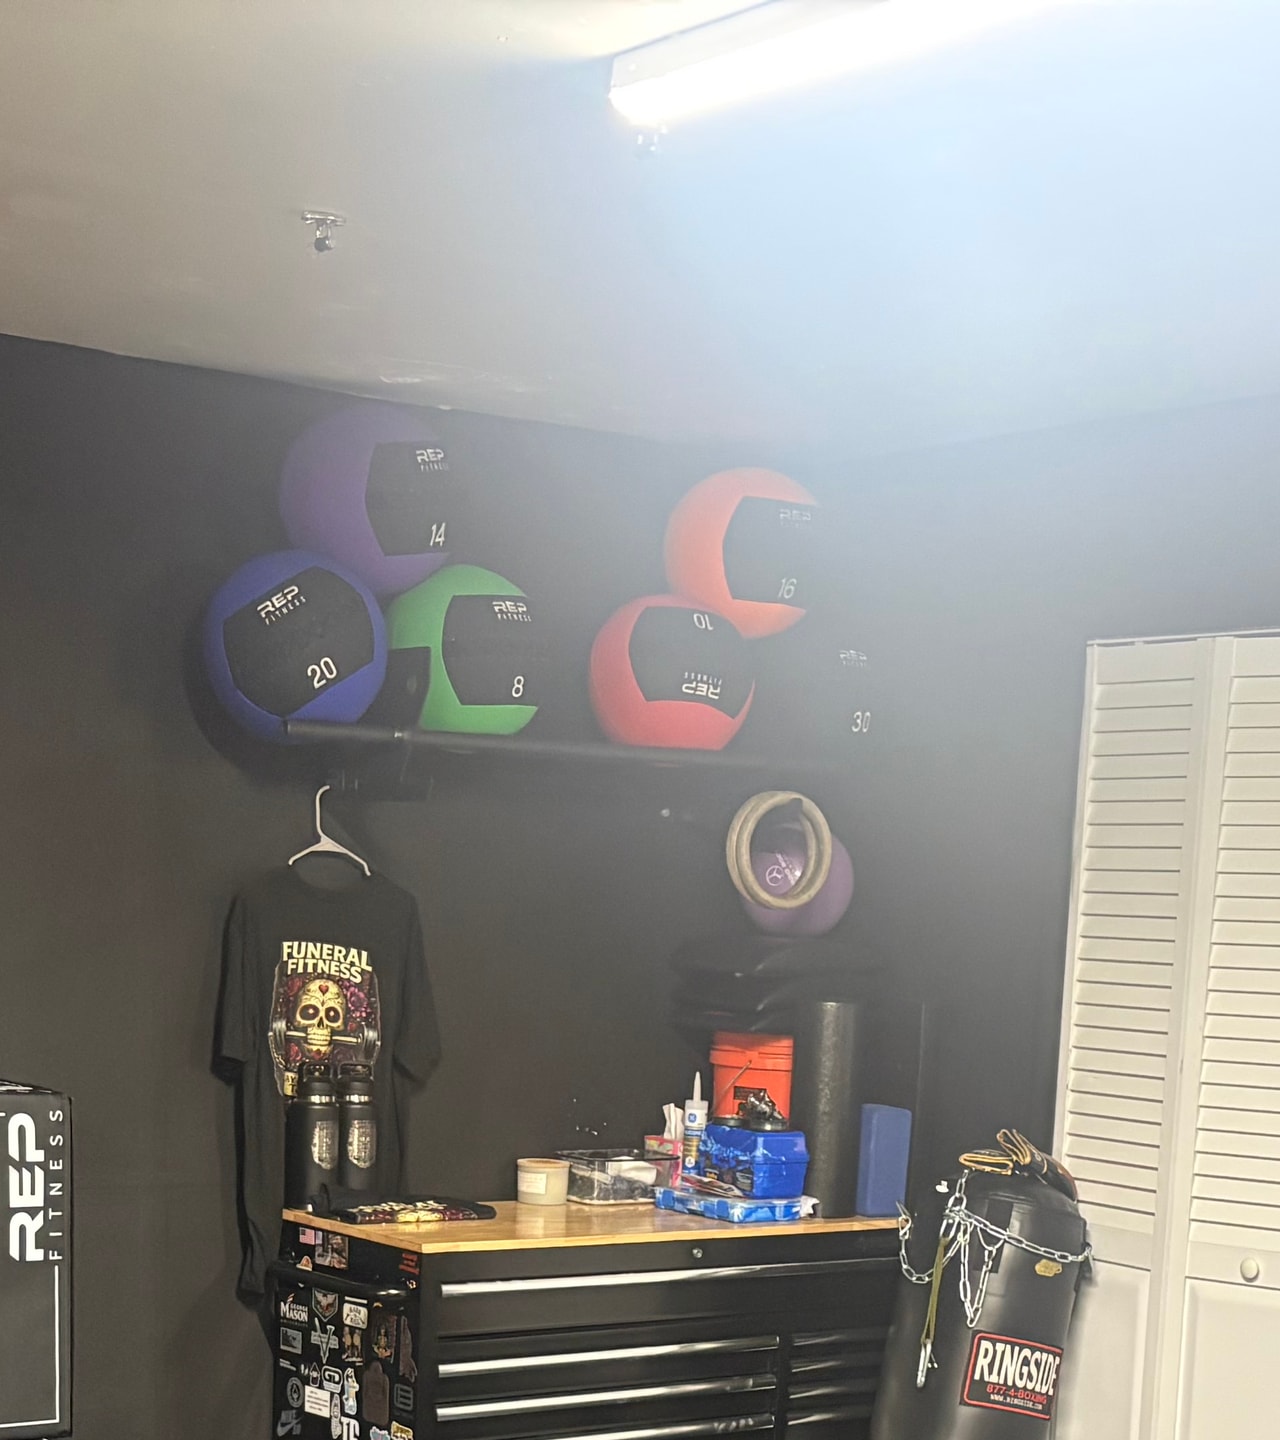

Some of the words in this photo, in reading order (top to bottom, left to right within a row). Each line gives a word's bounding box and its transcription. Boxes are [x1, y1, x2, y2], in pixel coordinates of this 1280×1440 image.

[416, 449, 444, 463] REP
[778, 509, 812, 521] REP
[430, 523, 446, 547] 14
[777, 578, 797, 599] 16
[256, 585, 300, 619] REP
[265, 596, 307, 625] FITNESS
[492, 601, 527, 614] REP
[693, 613, 714, 631] 10
[839, 650, 868, 661] REP
[307, 657, 337, 689] 20
[511, 676, 525, 697] 8
[682, 682, 721, 700] REP
[851, 711, 871, 732] 30
[282, 941, 373, 972] FUNERAL
[287, 959, 362, 984] FITNESS
[8, 1113, 45, 1262] REP
[49, 1109, 63, 1260] FITNESS
[280, 1301, 309, 1322] MASON
[973, 1340, 1060, 1396] RINGSIDE
[986, 1384, 1047, 1404] 877-4-BOXING
